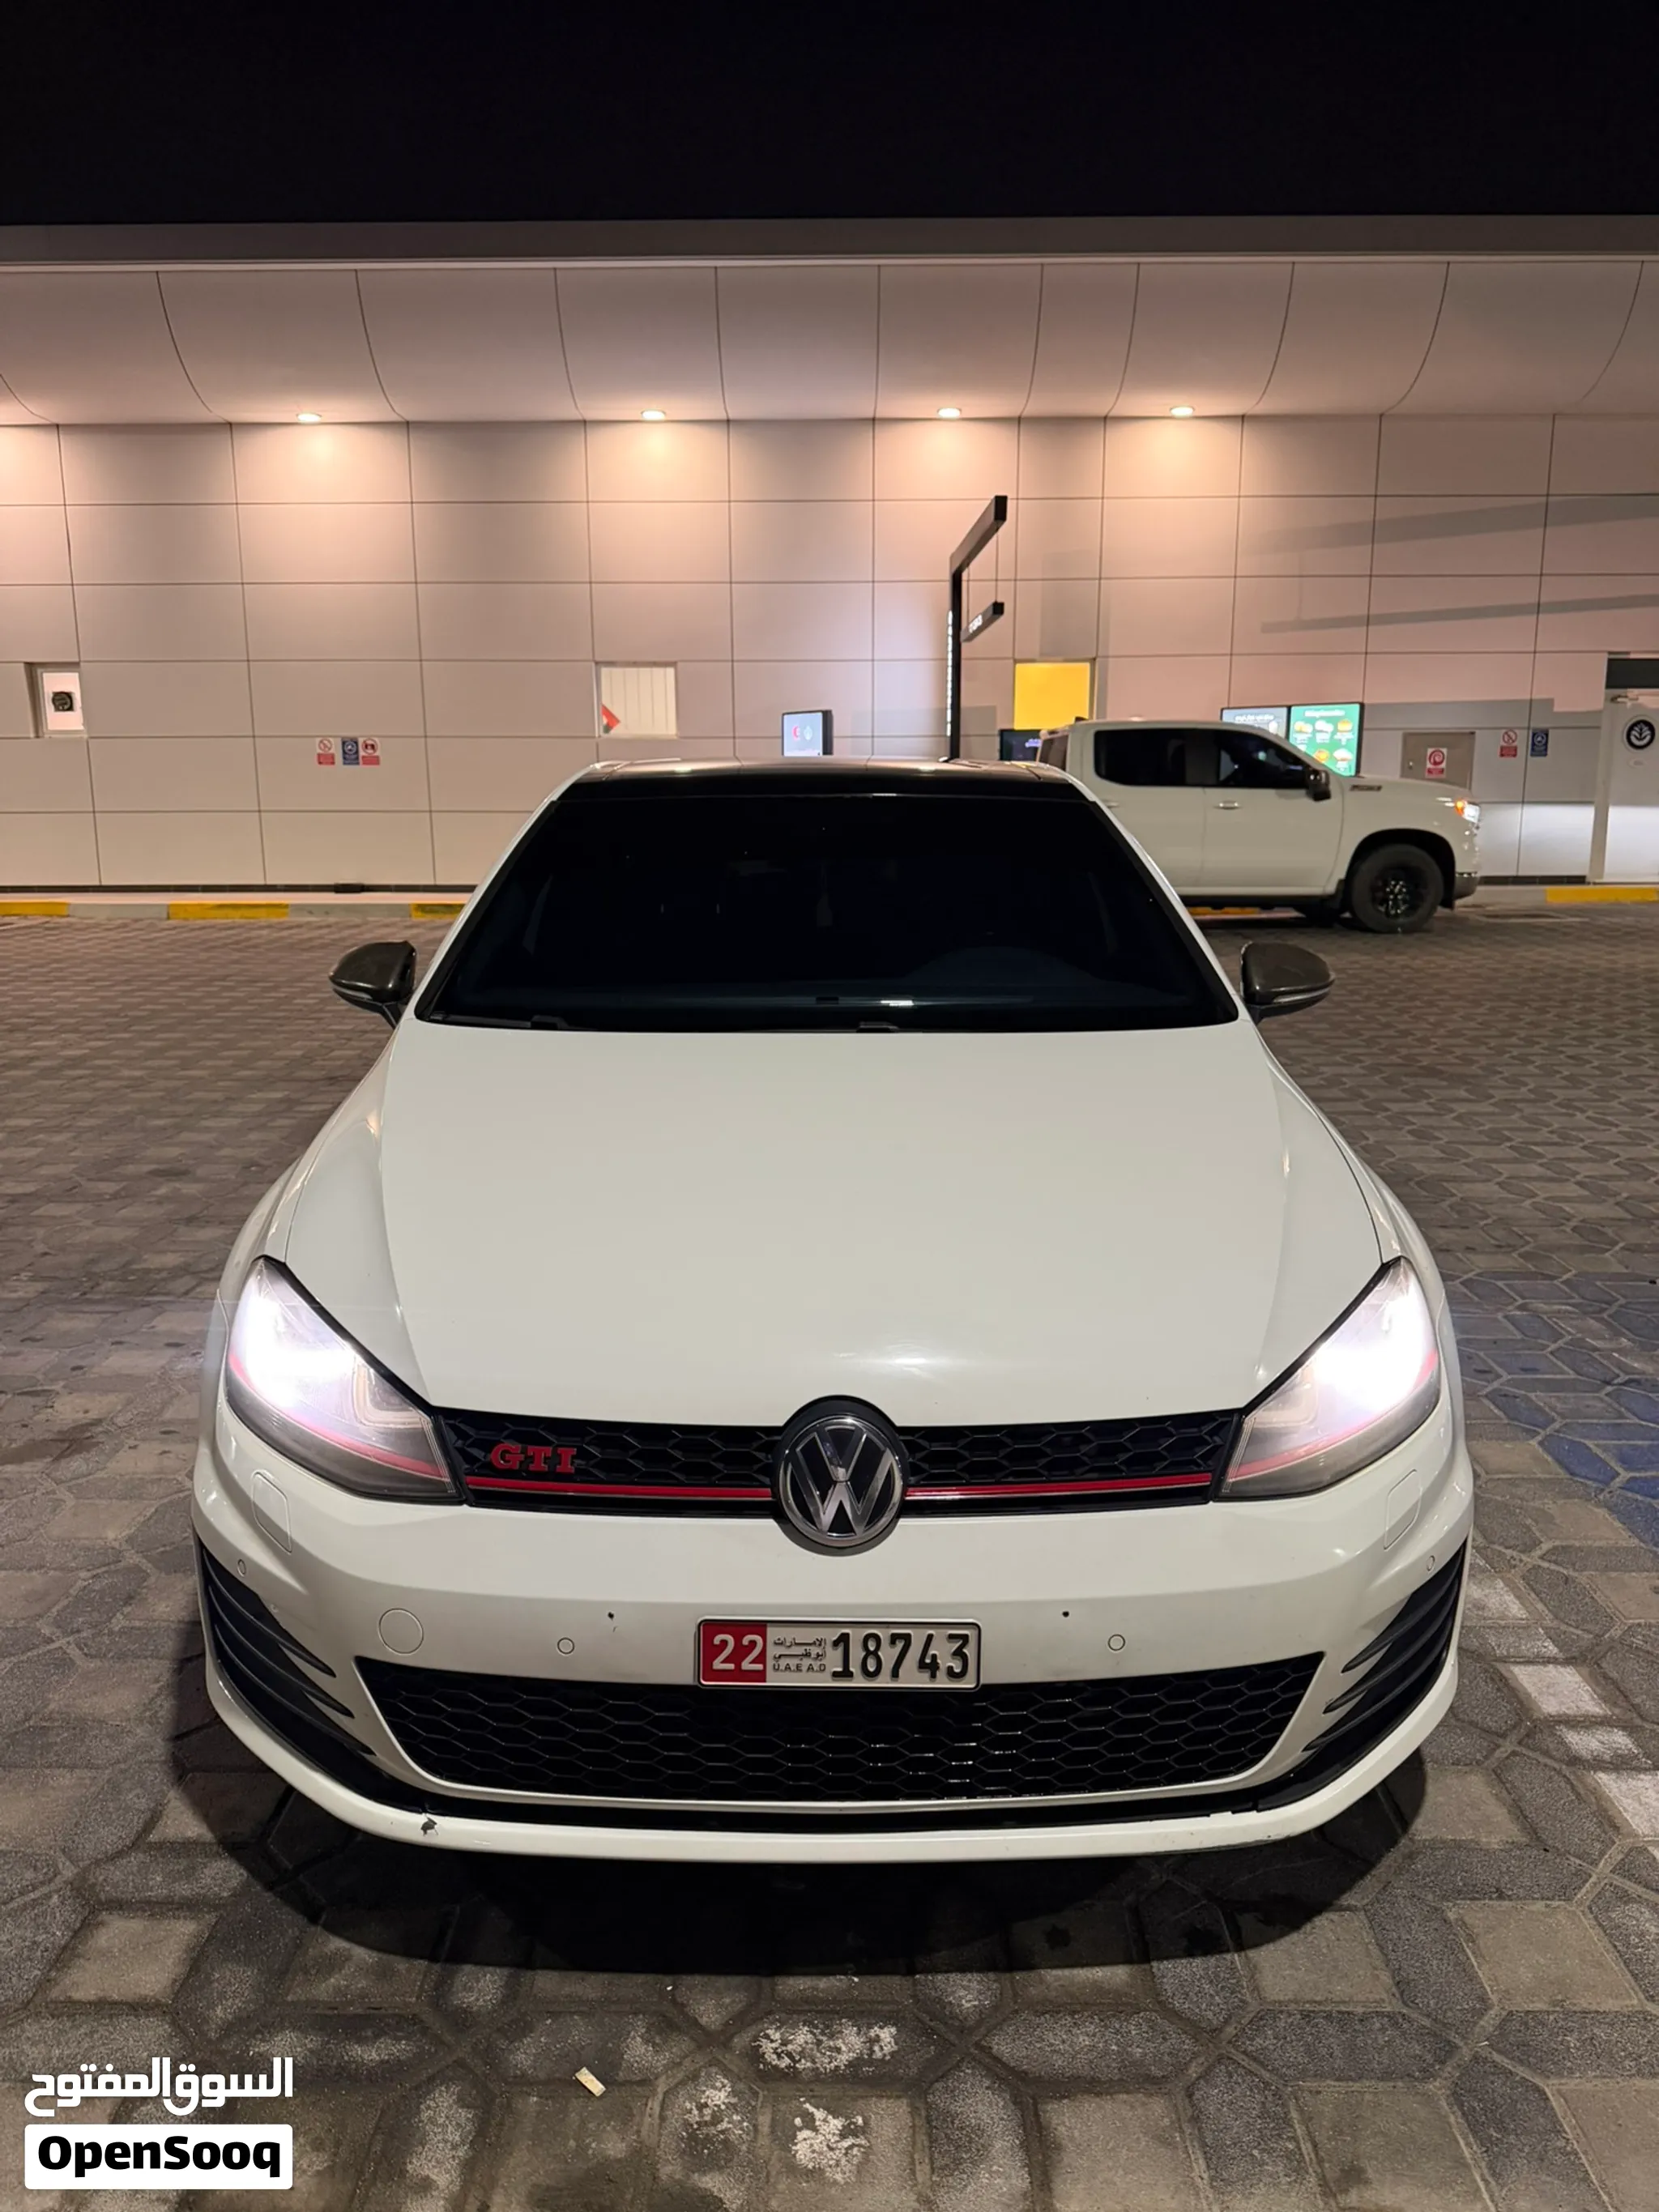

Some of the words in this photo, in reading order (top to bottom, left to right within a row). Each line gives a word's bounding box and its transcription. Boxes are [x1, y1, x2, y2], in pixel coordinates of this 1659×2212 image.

[489, 1443, 577, 1474] GTI
[712, 1633, 764, 1671] 22
[831, 1631, 970, 1680] 18743
